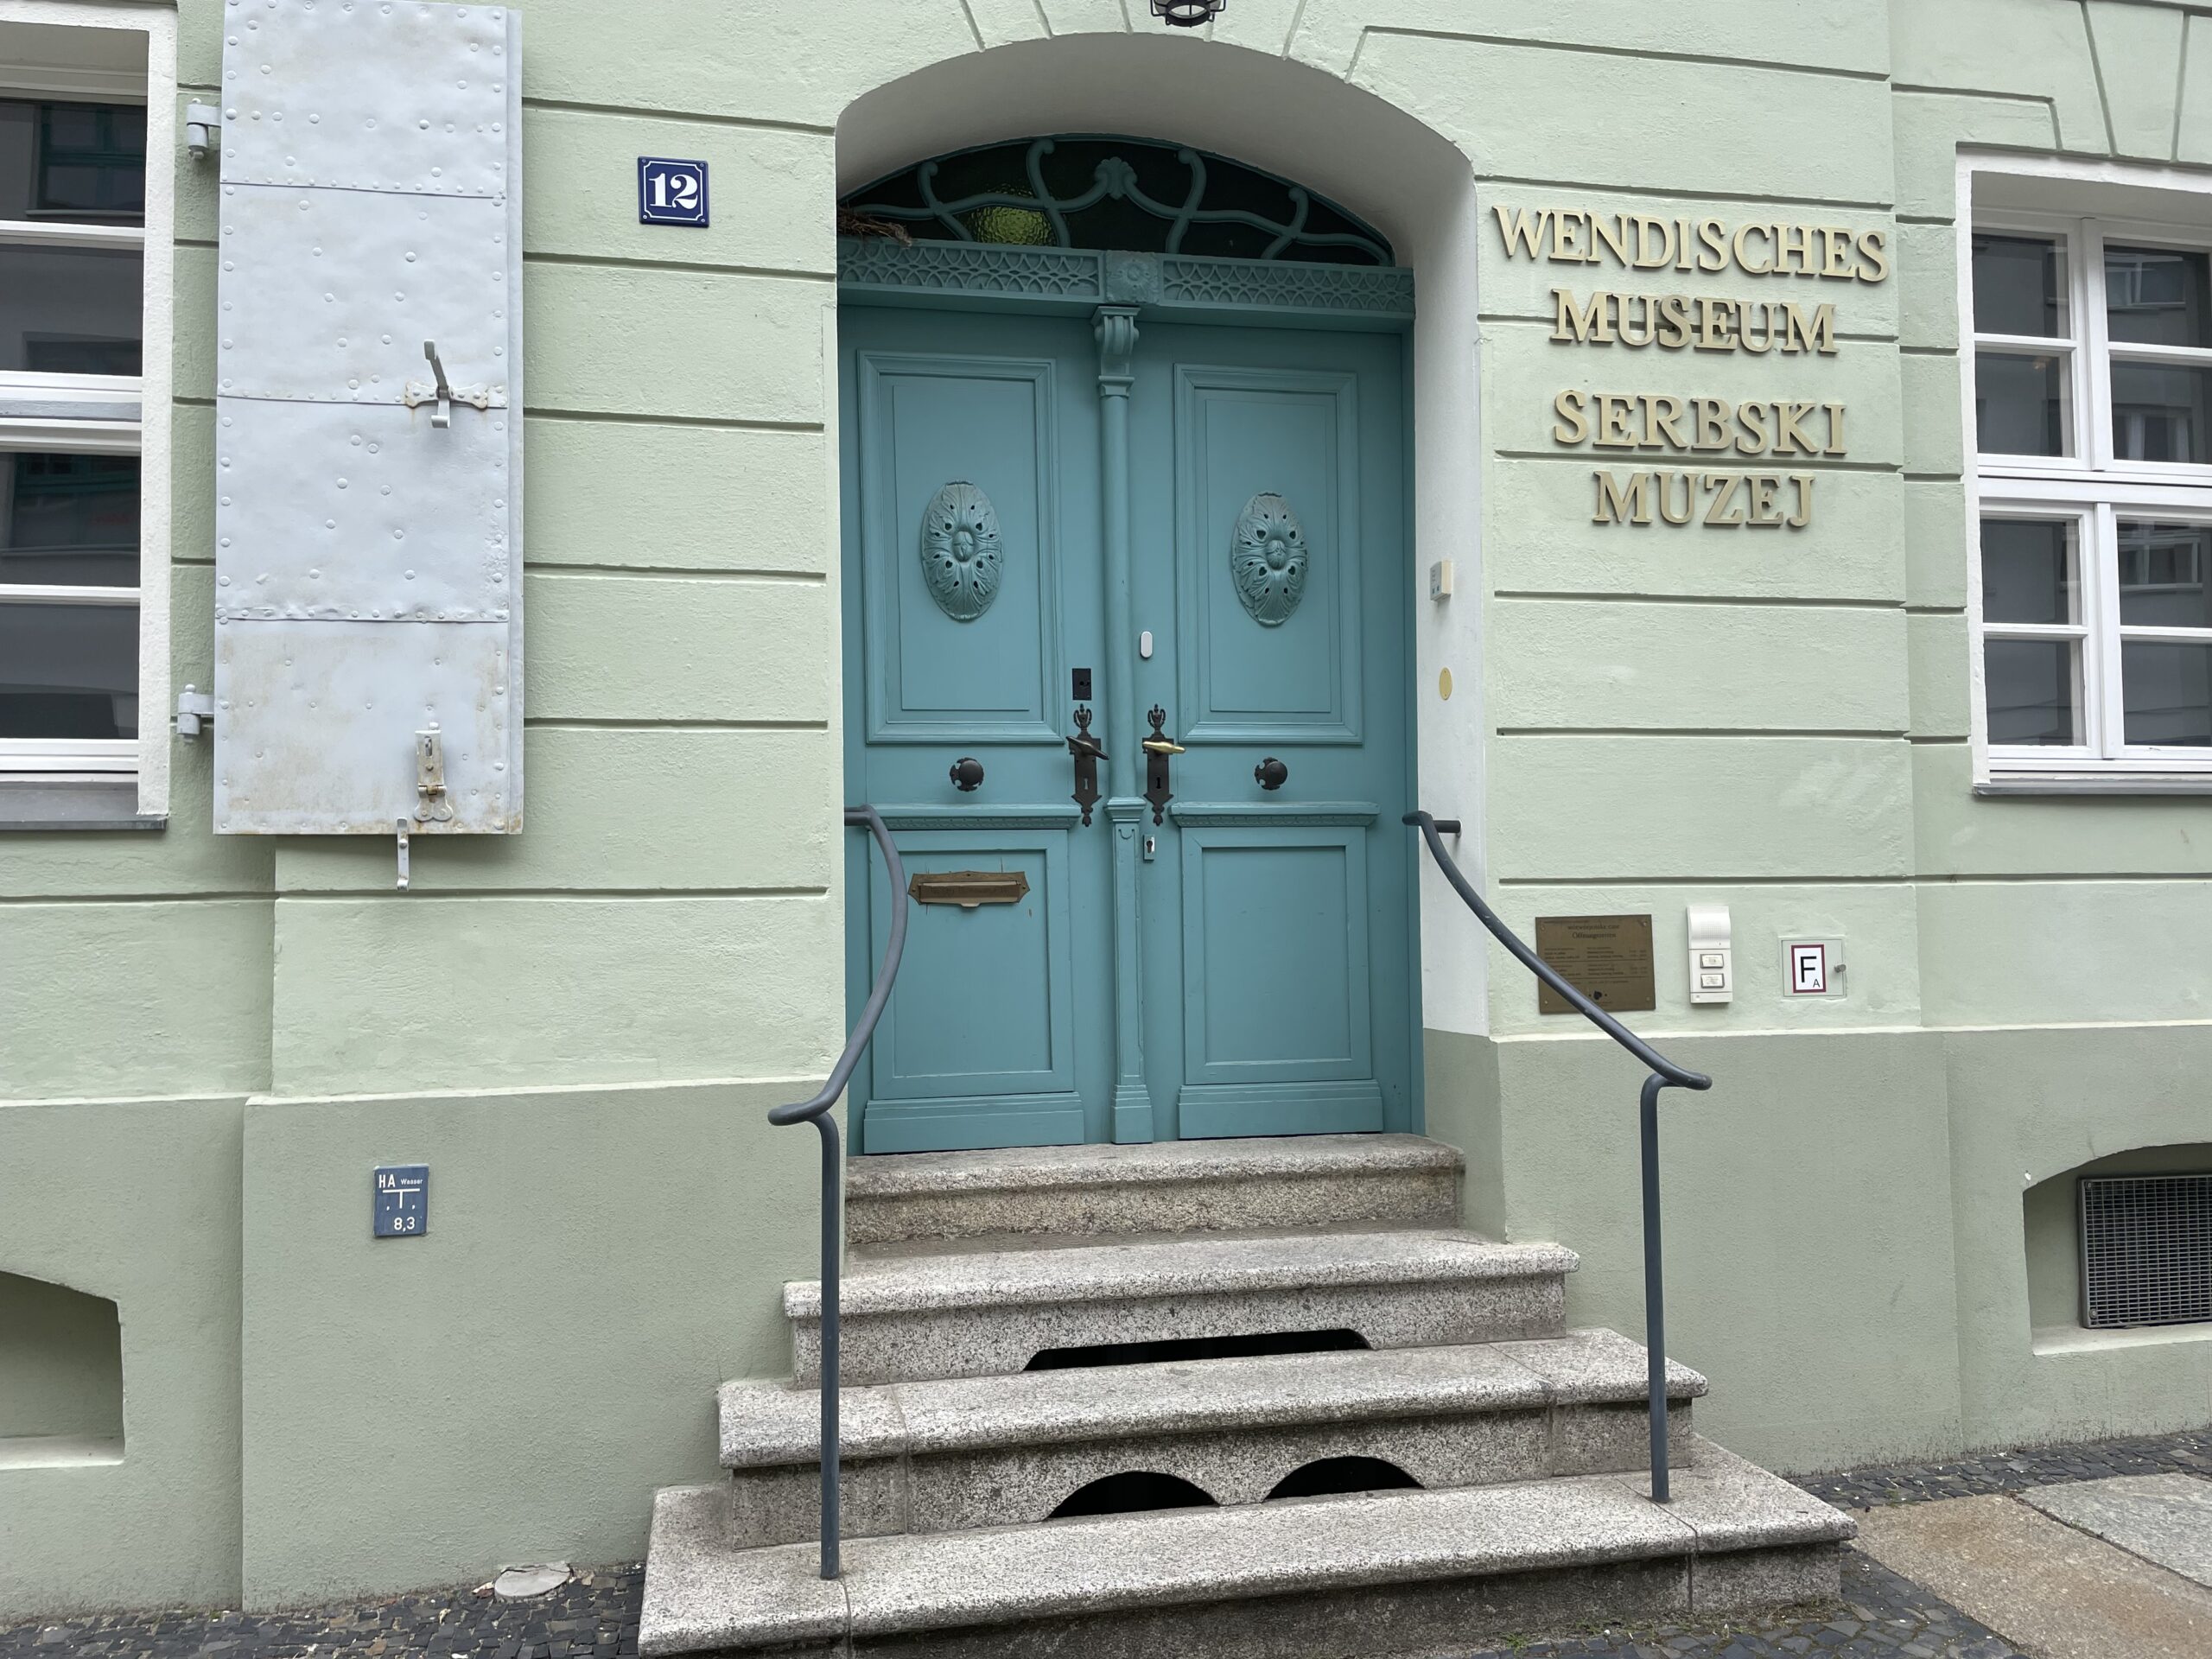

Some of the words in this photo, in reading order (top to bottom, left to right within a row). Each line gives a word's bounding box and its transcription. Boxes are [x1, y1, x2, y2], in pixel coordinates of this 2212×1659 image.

[649, 173, 698, 209] 12
[1492, 205, 1890, 282] WENDISCHES
[1549, 288, 1840, 353] MUSEUM
[1554, 390, 1847, 454] SERBSKI
[1593, 470, 1816, 527] MUZEJ
[1800, 956, 1817, 983] F
[1812, 978, 1821, 988] A
[378, 1173, 396, 1188] HA
[393, 1217, 416, 1232] 8,3
